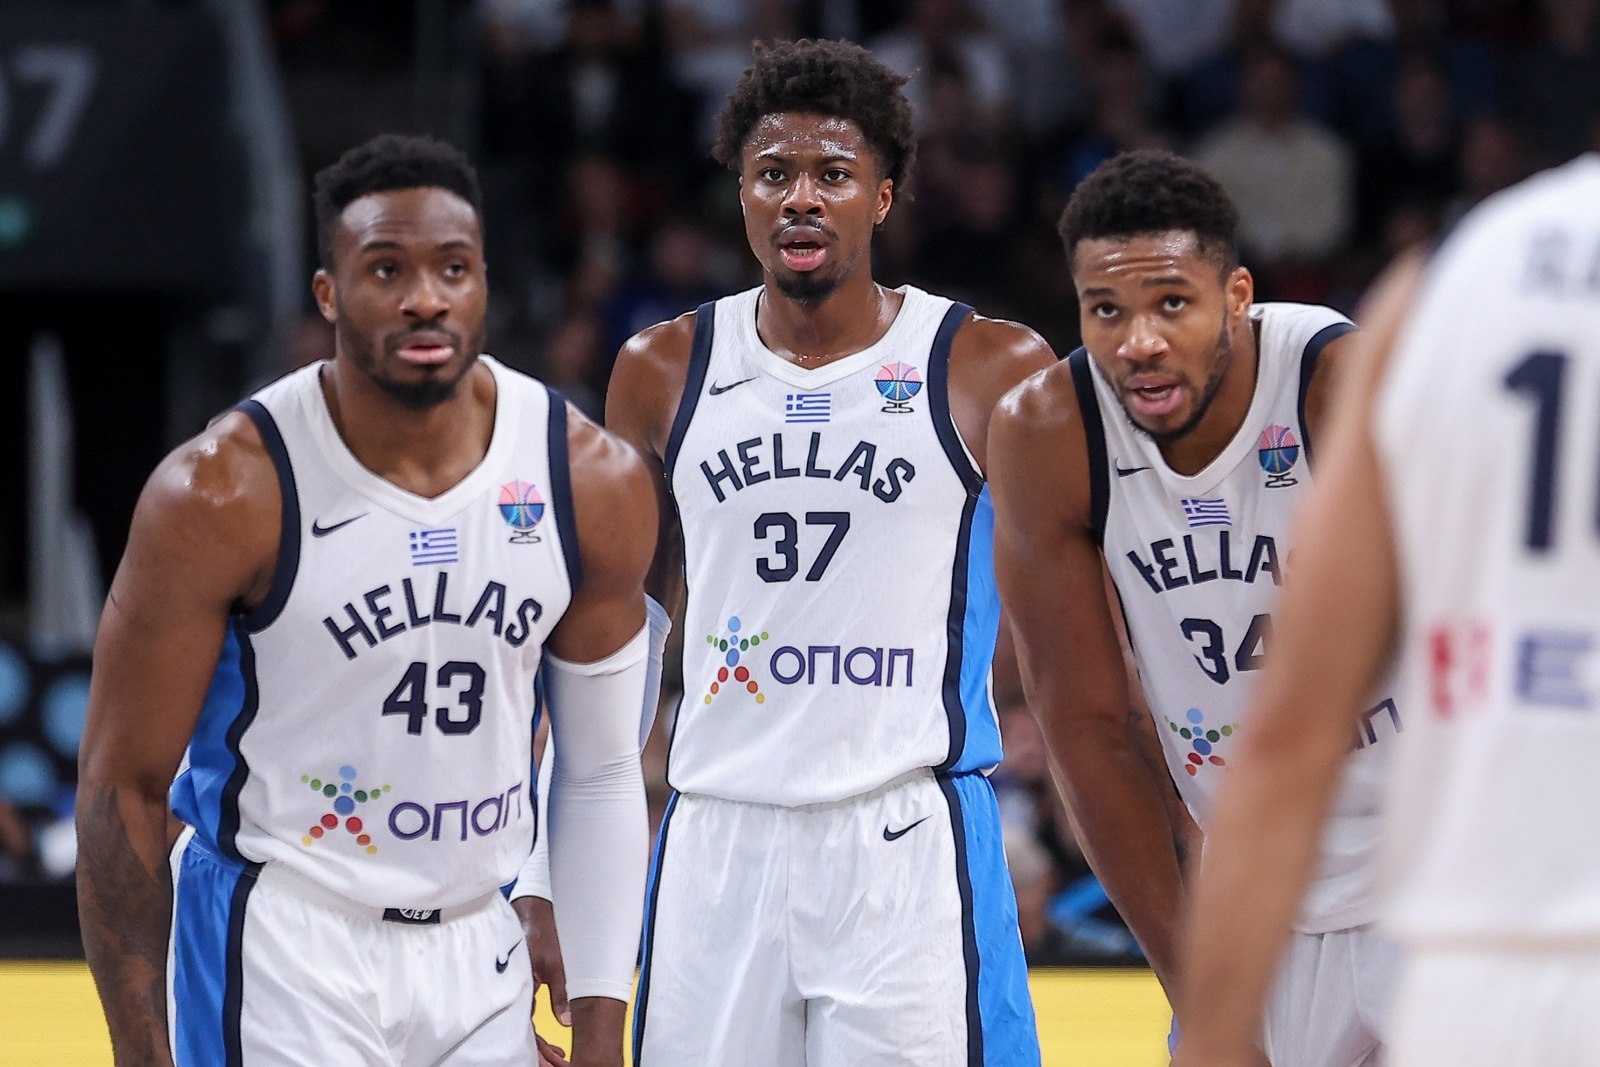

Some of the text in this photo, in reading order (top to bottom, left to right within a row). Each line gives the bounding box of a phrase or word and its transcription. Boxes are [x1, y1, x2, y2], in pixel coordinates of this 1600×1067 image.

[700, 431, 916, 504] HELLAS
[753, 511, 851, 584] 37
[322, 571, 543, 661] HELLAS
[381, 660, 487, 737] 43
